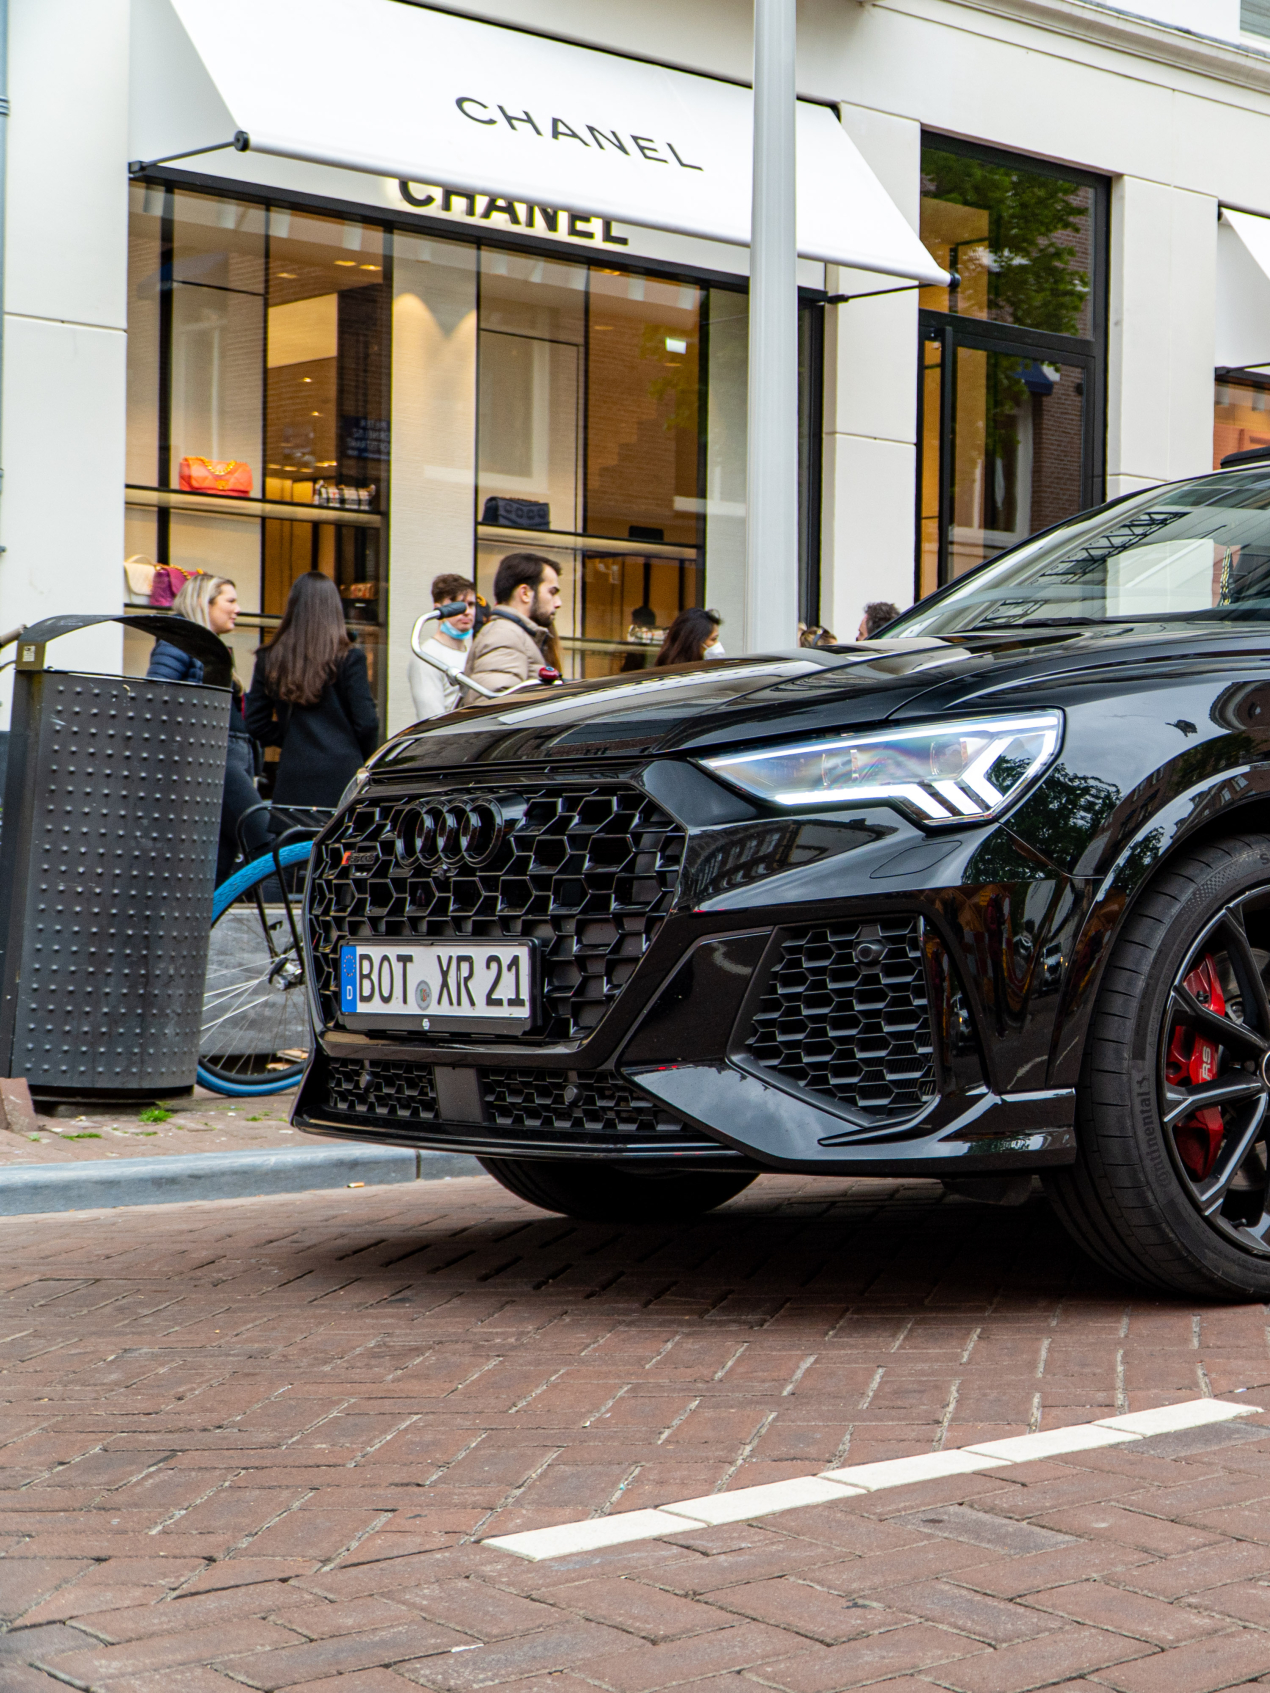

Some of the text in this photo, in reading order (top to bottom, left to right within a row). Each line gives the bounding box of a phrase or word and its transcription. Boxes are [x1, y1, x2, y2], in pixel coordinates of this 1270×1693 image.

[455, 96, 704, 172] CHANEL
[398, 179, 629, 246] CHANEL
[346, 985, 353, 1000] D
[358, 953, 414, 1005] BOT
[436, 954, 477, 1007] XR
[485, 954, 527, 1007] 21
[1202, 1046, 1211, 1081] RS
[1137, 1090, 1172, 1186] Continental
